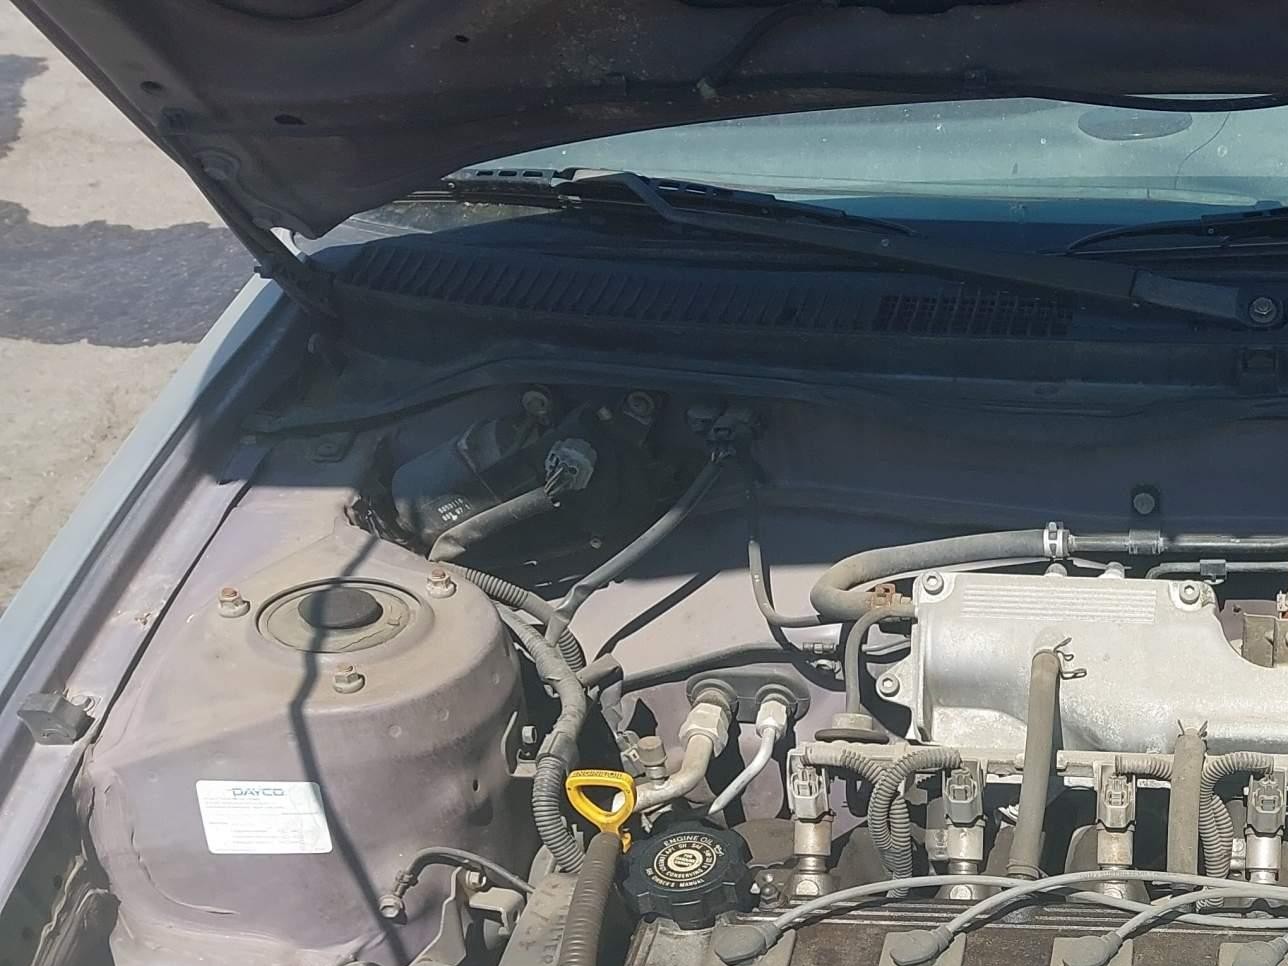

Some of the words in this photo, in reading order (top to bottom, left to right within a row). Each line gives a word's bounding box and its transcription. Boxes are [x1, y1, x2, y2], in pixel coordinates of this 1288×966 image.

[231, 787, 285, 797] DAYCO
[663, 835, 700, 847] ENGINE
[700, 836, 714, 846] OIL
